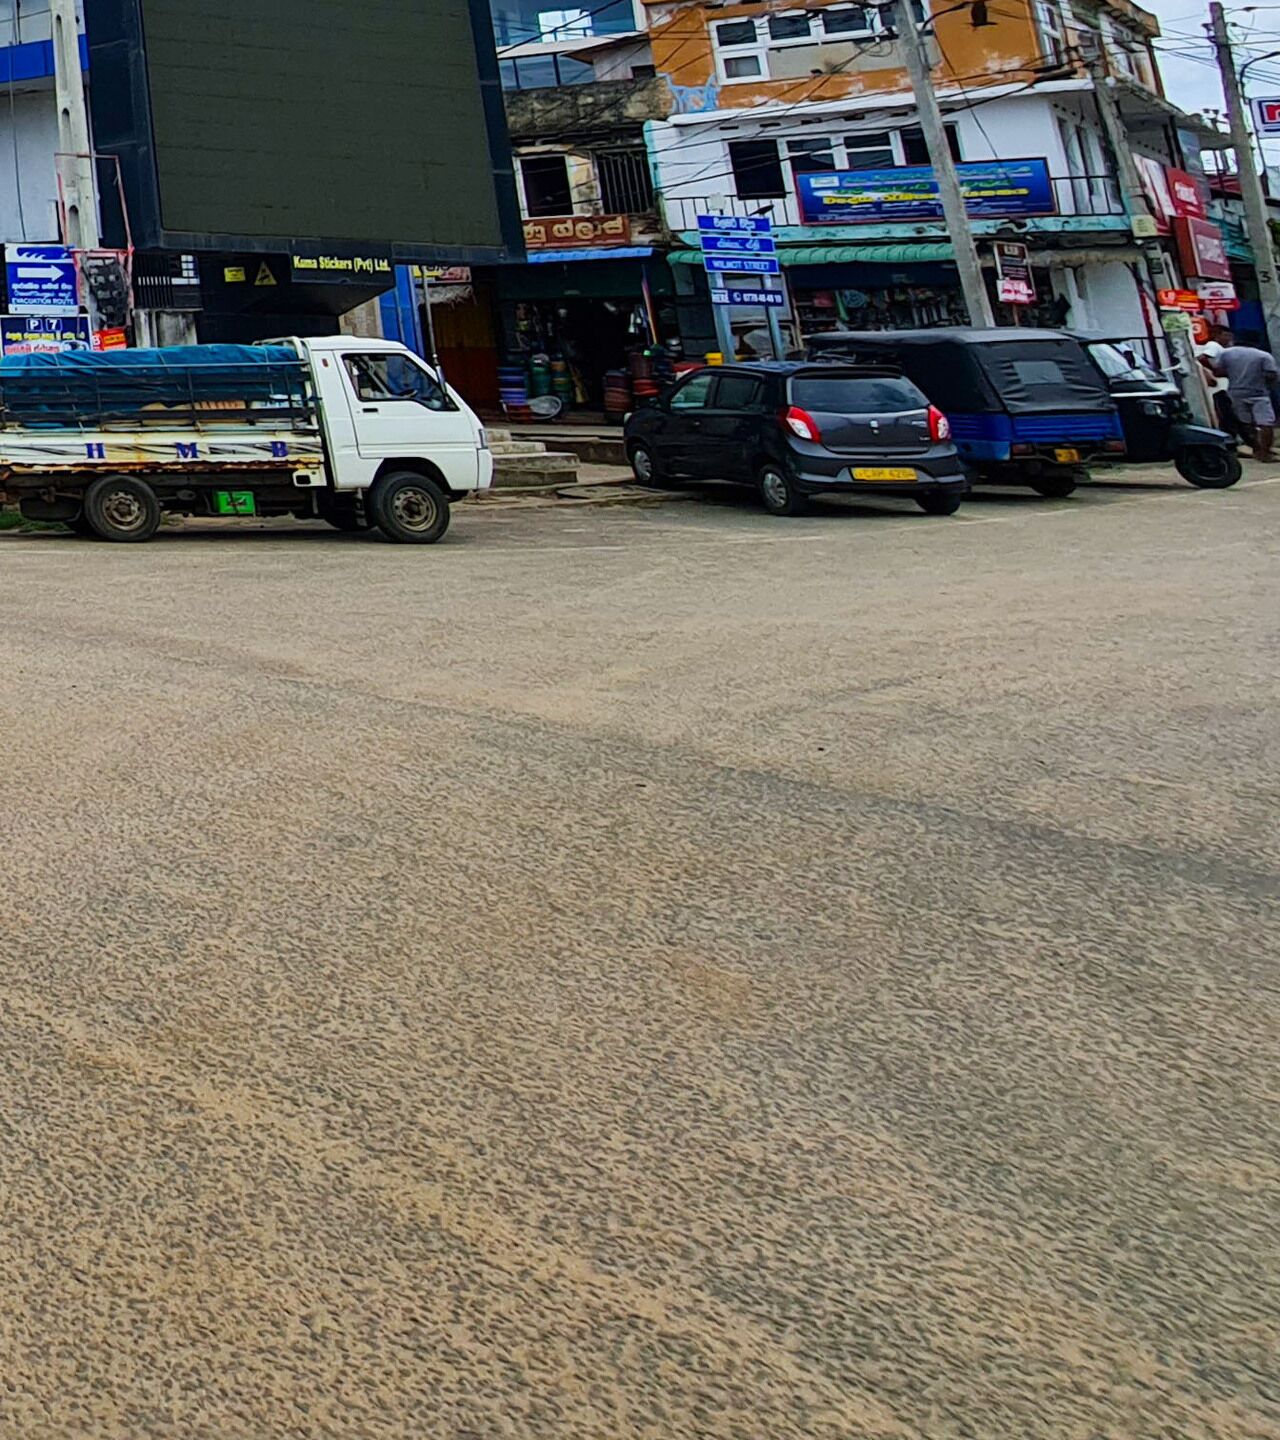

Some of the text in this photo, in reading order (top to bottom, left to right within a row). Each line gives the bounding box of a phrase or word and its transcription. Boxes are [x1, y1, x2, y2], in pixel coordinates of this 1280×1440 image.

[294, 256, 317, 269] Kuma
[319, 256, 352, 270] Stickers
[354, 257, 373, 274] (Pvt)
[743, 261, 769, 270] STREET
[1259, 270, 1271, 284] 3
[30, 320, 57, 329] P 7
[86, 440, 290, 459] H M B
